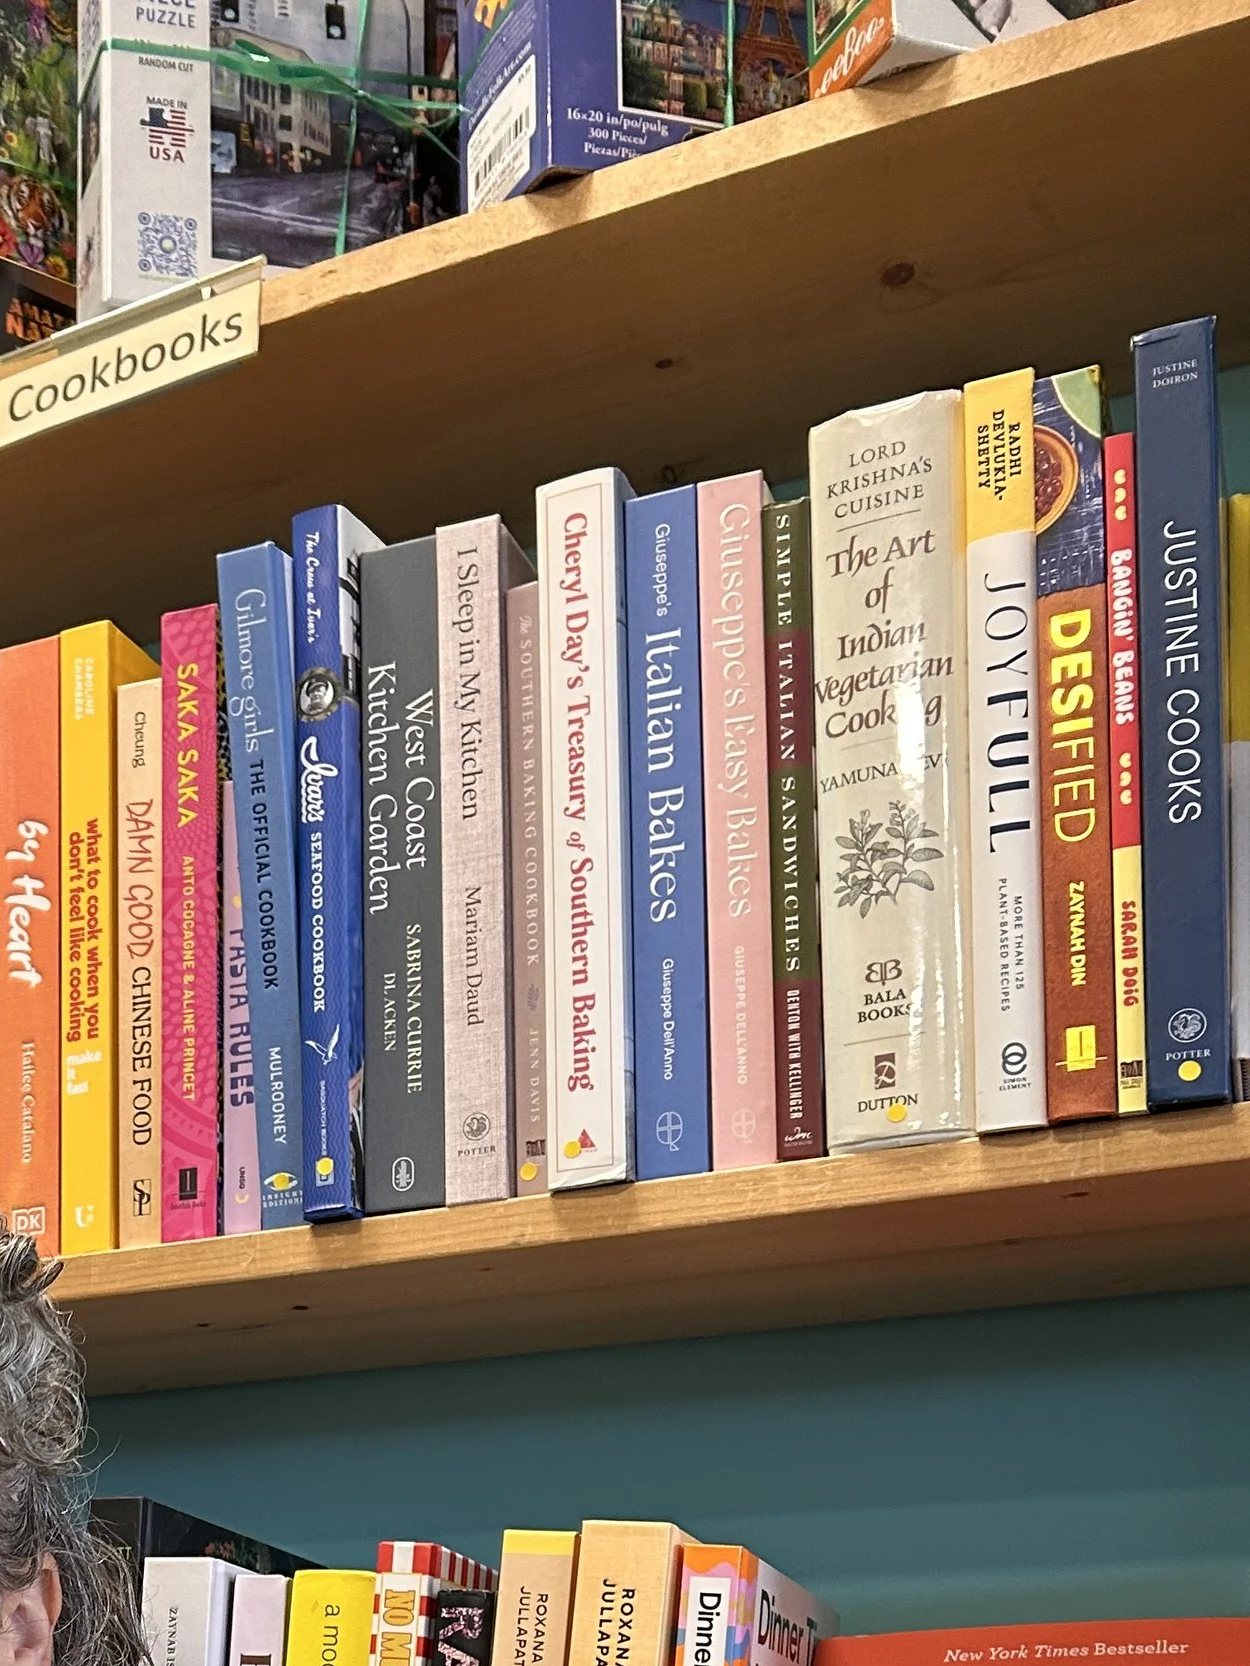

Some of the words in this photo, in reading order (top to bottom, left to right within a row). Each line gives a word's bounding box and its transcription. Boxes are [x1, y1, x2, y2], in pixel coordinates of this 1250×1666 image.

[135, 7, 196, 29] PUZZLE
[137, 56, 175, 71] RANDOM
[177, 60, 194, 73] CUT
[815, 16, 885, 98] eeBoo
[145, 96, 176, 108] MADE
[177, 98, 188, 110] IN
[150, 145, 185, 164] USA
[7, 309, 244, 424] Cookbooks
[1152, 358, 1198, 379] JUSTINE
[1152, 370, 1198, 390] DOIRON
[827, 456, 933, 500] KRISHNA'S
[849, 441, 906, 467] LORD
[978, 425, 991, 489] SHETTY
[992, 409, 1007, 500] DEVLUKIA-
[1008, 422, 1022, 477] RADHI
[835, 484, 925, 519] CUISINE
[652, 523, 671, 617] Giuseppe's
[826, 535, 878, 578] The
[884, 529, 936, 562] Art
[865, 567, 894, 614] of
[1162, 520, 1199, 677] JUSTINE
[234, 588, 267, 690] Gilmore
[838, 620, 926, 660] Indian
[177, 663, 199, 742] SAKA
[645, 627, 683, 773] Italian
[814, 655, 954, 707] Vegetarian
[983, 572, 1031, 853] JOYFULL
[132, 711, 147, 769] Cheung
[230, 696, 274, 753] girls
[368, 661, 401, 786] Kitchen
[405, 688, 434, 769] West
[1050, 608, 1095, 842] DESIFIED
[1166, 689, 1202, 824] COOKS
[177, 748, 199, 828] SAKA
[250, 759, 264, 794] THE
[820, 762, 899, 793] YAMUNA
[125, 799, 155, 874] DAMN
[252, 803, 271, 885] OFFICIAL
[368, 793, 401, 915] Garden
[405, 776, 435, 871] Coast
[648, 785, 685, 922] Bakes
[123, 885, 155, 960] GOOD
[258, 891, 278, 990] COOKBOOK
[1069, 881, 1085, 952] ZAYNAH
[406, 923, 422, 1012] SABRINA
[662, 958, 674, 1018] Giuseppe
[864, 989, 907, 1006] BALA
[1070, 955, 1086, 987] DIN
[131, 966, 153, 1072] CHINESE
[663, 1021, 675, 1080] Dell'Anno
[407, 1016, 423, 1094] CURRIE
[1166, 1048, 1210, 1062] POTTER
[132, 1078, 153, 1146] FOOD
[269, 1047, 287, 1145] MULROONEY
[857, 1094, 918, 1113] DUTTON
[383, 1589, 416, 1627] NO
[943, 1648, 983, 1664] New
[988, 1645, 1028, 1661] York
[1034, 1643, 1089, 1660] Times
[1093, 1639, 1189, 1658] Bestseller
